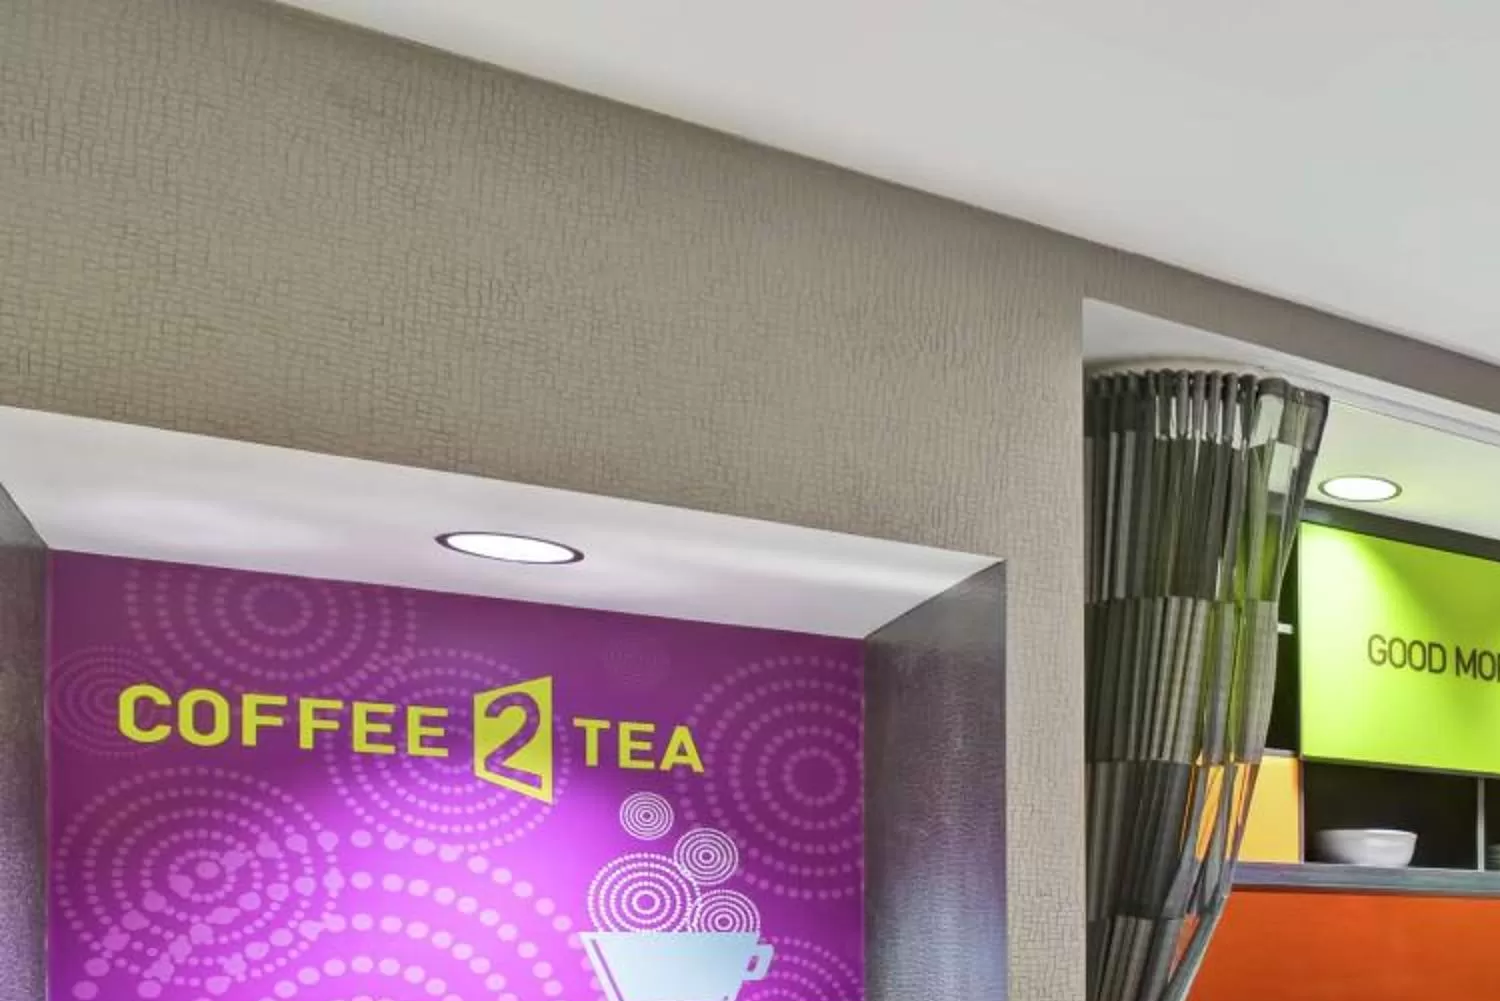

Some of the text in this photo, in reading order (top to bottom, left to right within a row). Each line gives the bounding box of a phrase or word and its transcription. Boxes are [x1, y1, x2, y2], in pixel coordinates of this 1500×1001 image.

[1367, 634, 1447, 674] GOOD
[118, 683, 704, 791] COFFEE 2 TEA
